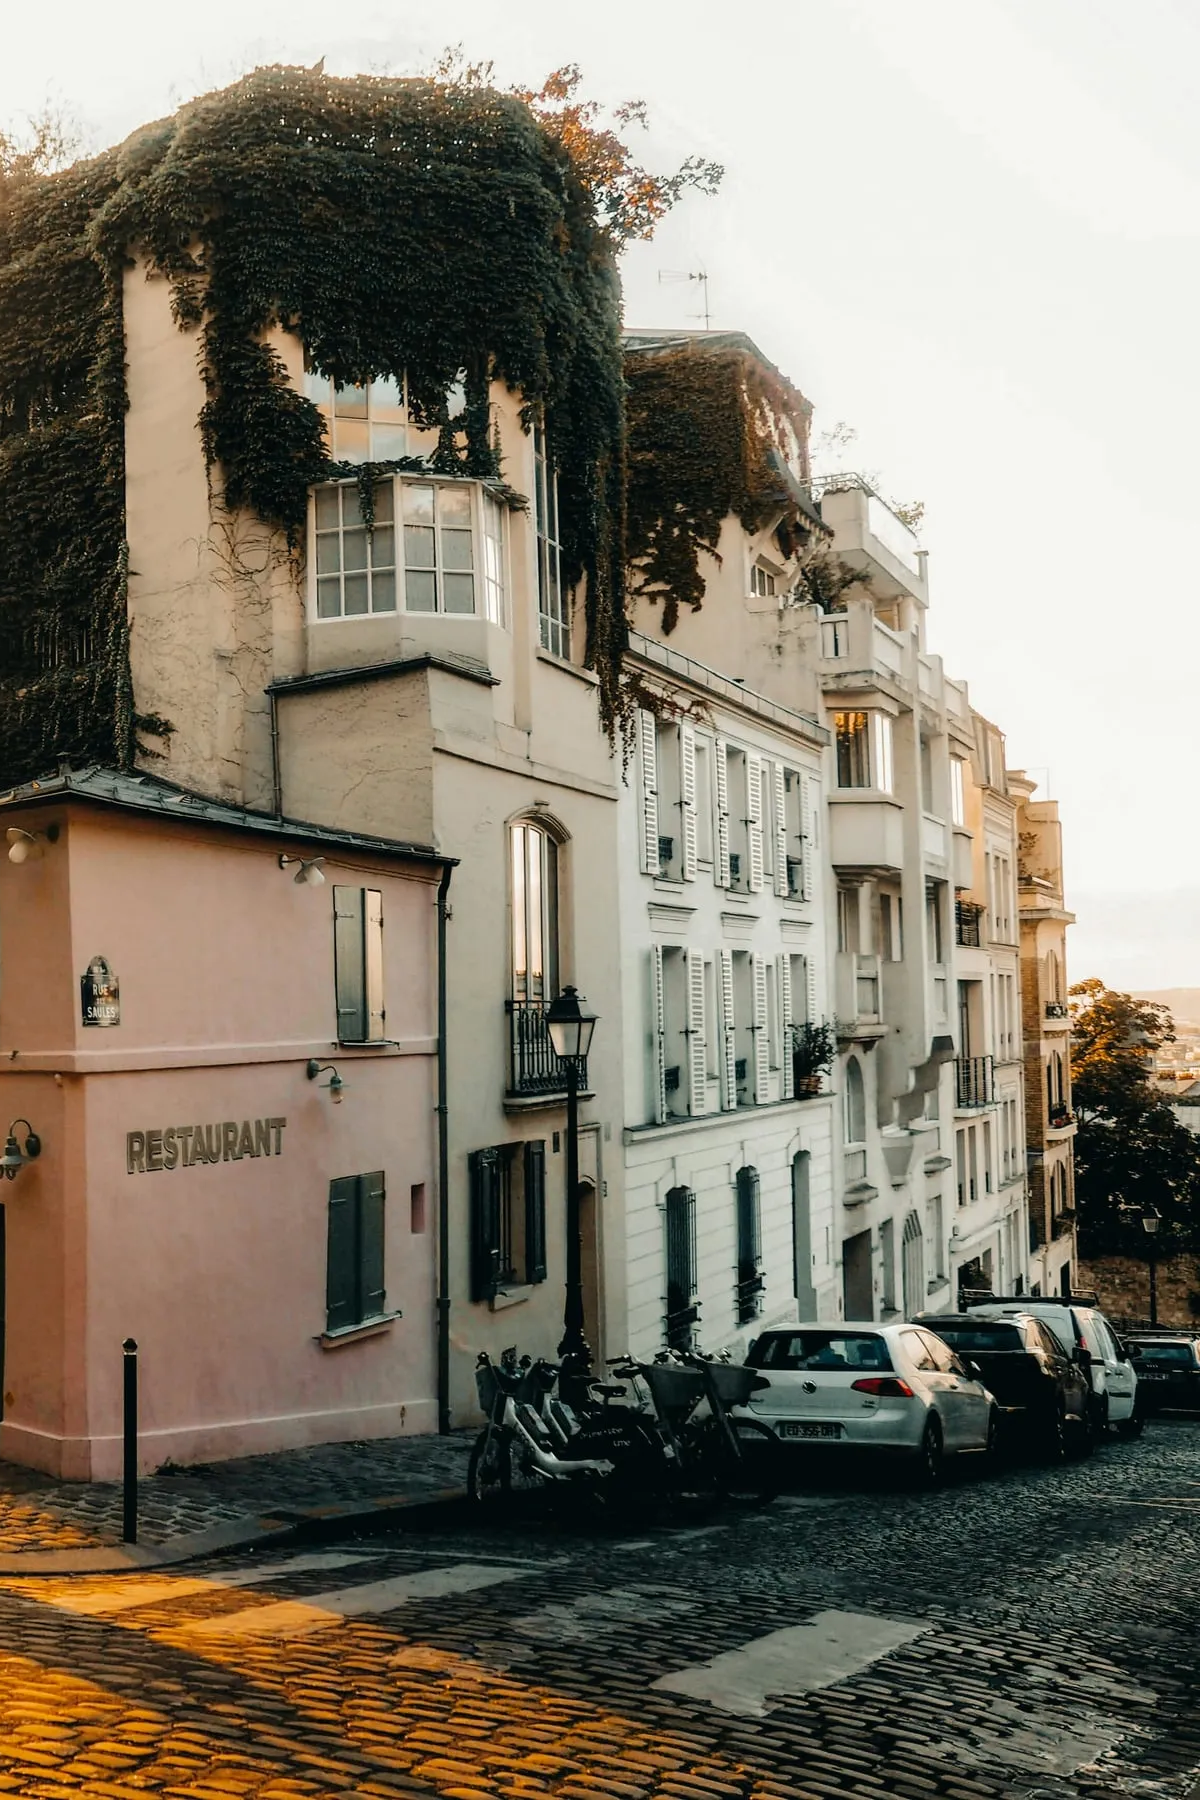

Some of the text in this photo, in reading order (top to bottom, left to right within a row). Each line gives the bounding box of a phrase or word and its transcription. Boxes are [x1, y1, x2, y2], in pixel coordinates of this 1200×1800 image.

[92, 984, 109, 996] RUE
[87, 1006, 116, 1018] SAULES
[127, 1117, 287, 1175] RESTAURANT
